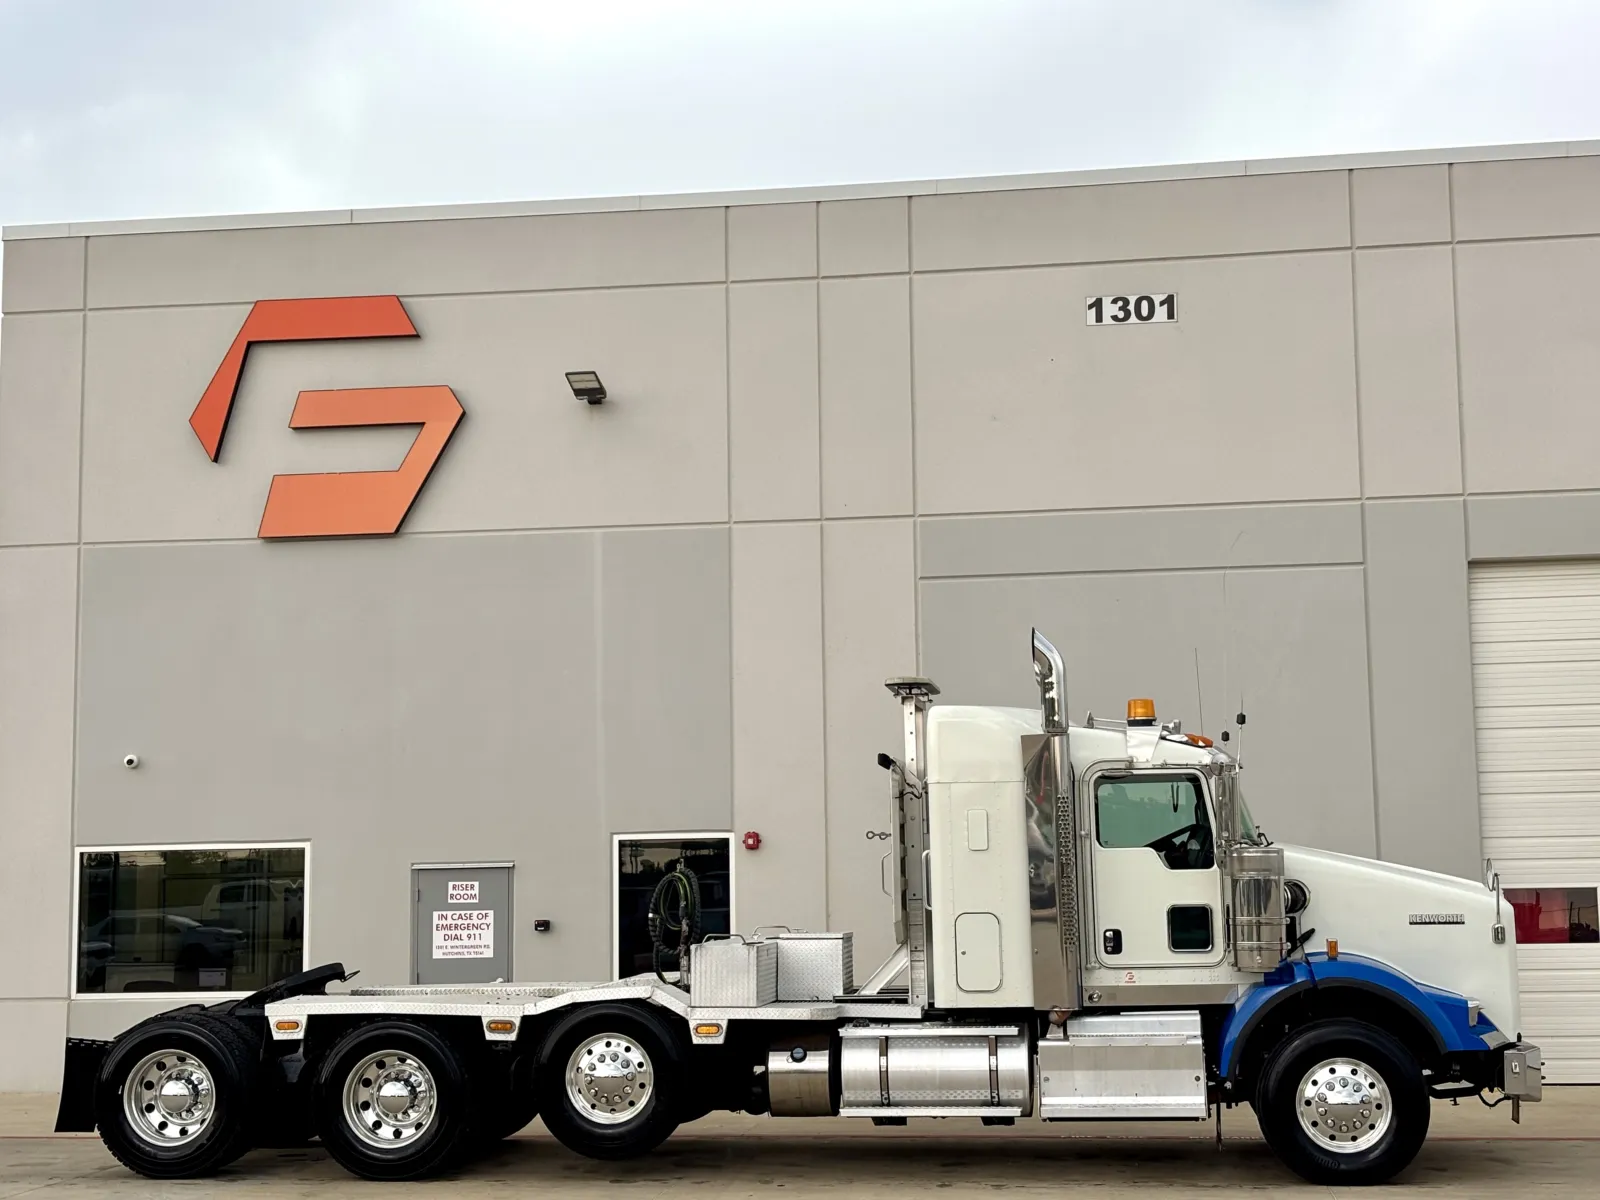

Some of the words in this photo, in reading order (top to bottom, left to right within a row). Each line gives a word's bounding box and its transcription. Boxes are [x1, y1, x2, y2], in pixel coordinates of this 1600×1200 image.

[1087, 294, 1175, 323] 1301
[452, 883, 475, 891] RISER
[449, 893, 477, 901] ROOM
[437, 913, 448, 921] IN
[450, 913, 474, 921] CASE
[476, 912, 489, 921] OF
[1409, 913, 1465, 925] KENWORTH
[435, 922, 491, 931] EMERGENCY
[443, 933, 464, 942] DIAL
[466, 932, 482, 941] 911
